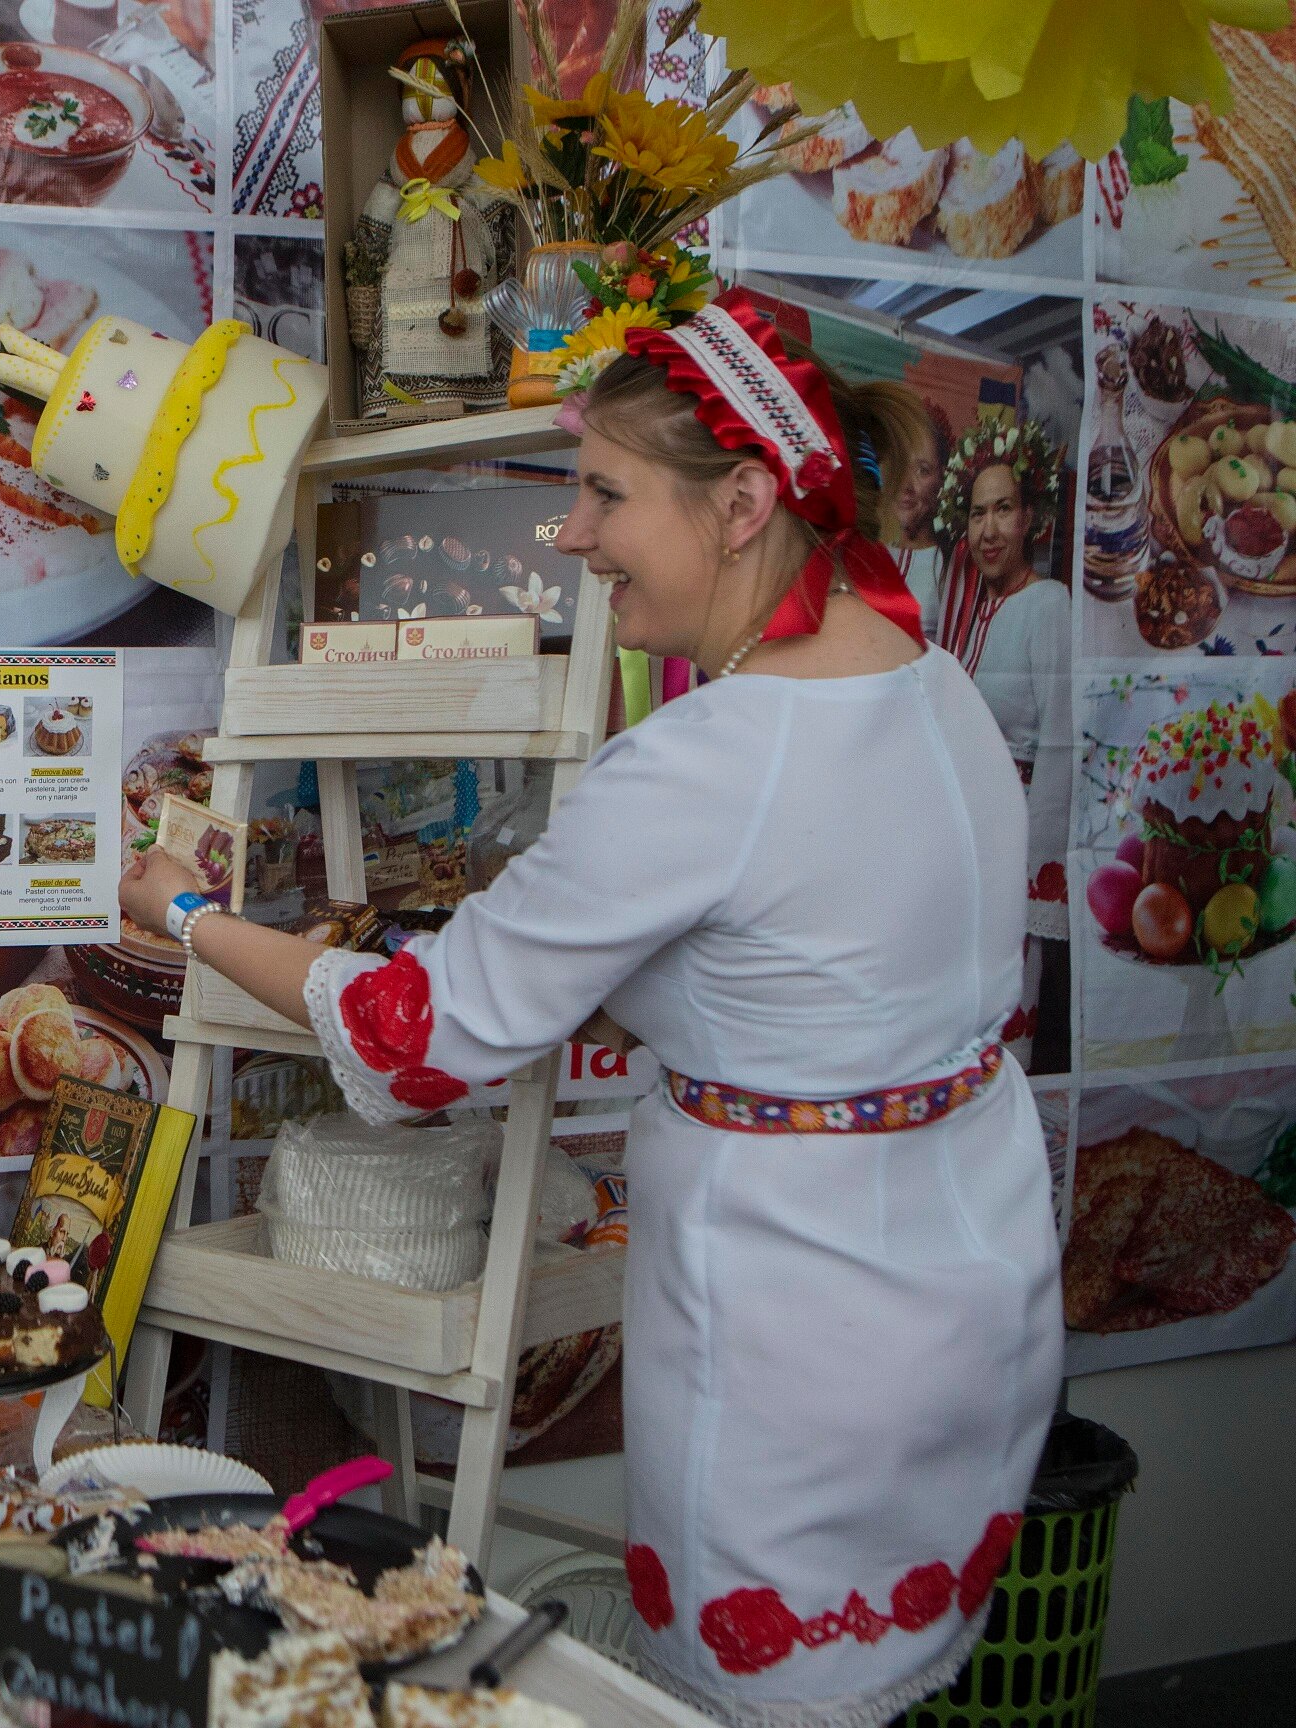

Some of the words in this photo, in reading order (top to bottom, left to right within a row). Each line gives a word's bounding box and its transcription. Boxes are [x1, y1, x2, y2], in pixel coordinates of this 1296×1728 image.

[535, 524, 563, 541] RO
[422, 642, 508, 660] Столичні
[40, 904, 70, 912] chocolate
